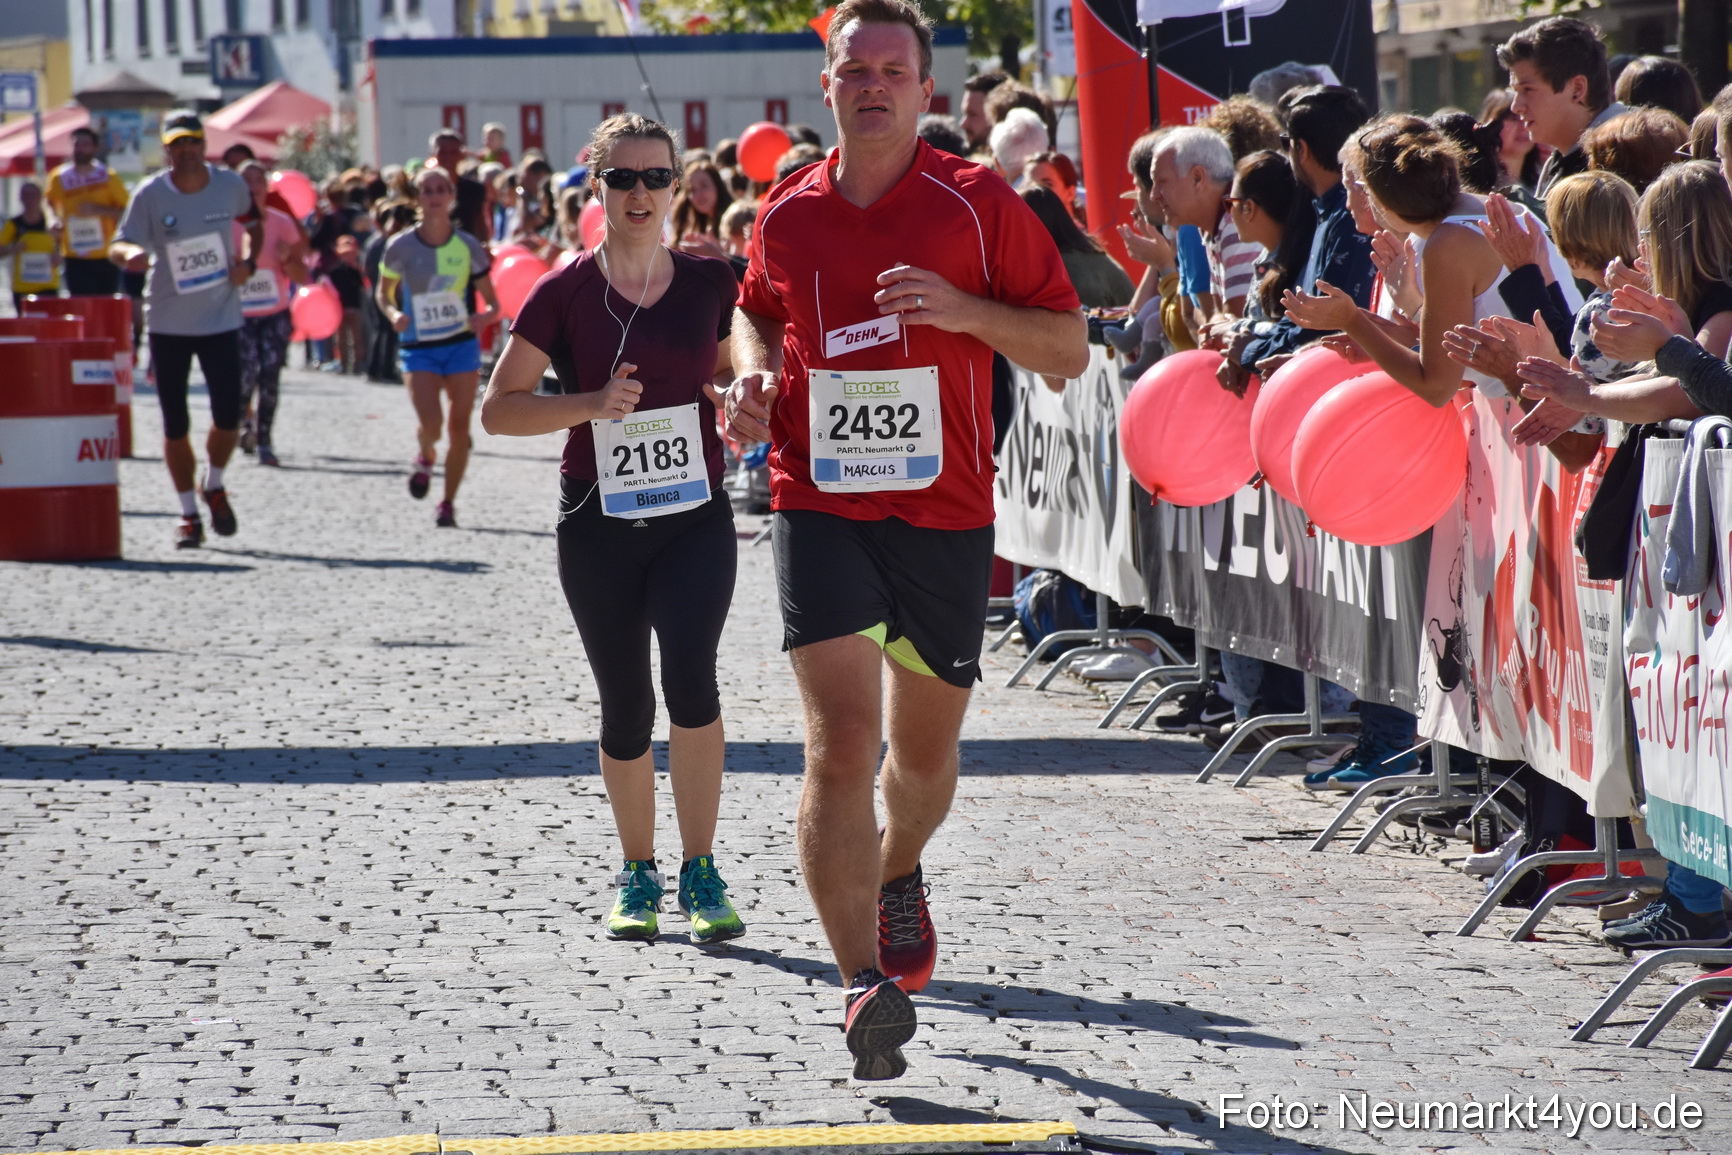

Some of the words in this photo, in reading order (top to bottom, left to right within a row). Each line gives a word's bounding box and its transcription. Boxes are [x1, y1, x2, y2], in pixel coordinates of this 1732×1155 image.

[178, 249, 218, 272] 2305
[845, 327, 880, 345] DEHN
[844, 381, 901, 394] BOCK
[624, 418, 673, 436] BOCK
[829, 403, 921, 440] 2432
[612, 437, 689, 477] 2183
[865, 445, 904, 454] Neumarkt
[844, 464, 896, 477] MARCUS
[623, 479, 647, 488] PARTL
[648, 473, 679, 484] Neumarkt
[636, 490, 680, 507] Bianca
[1480, 818, 1490, 839] now
